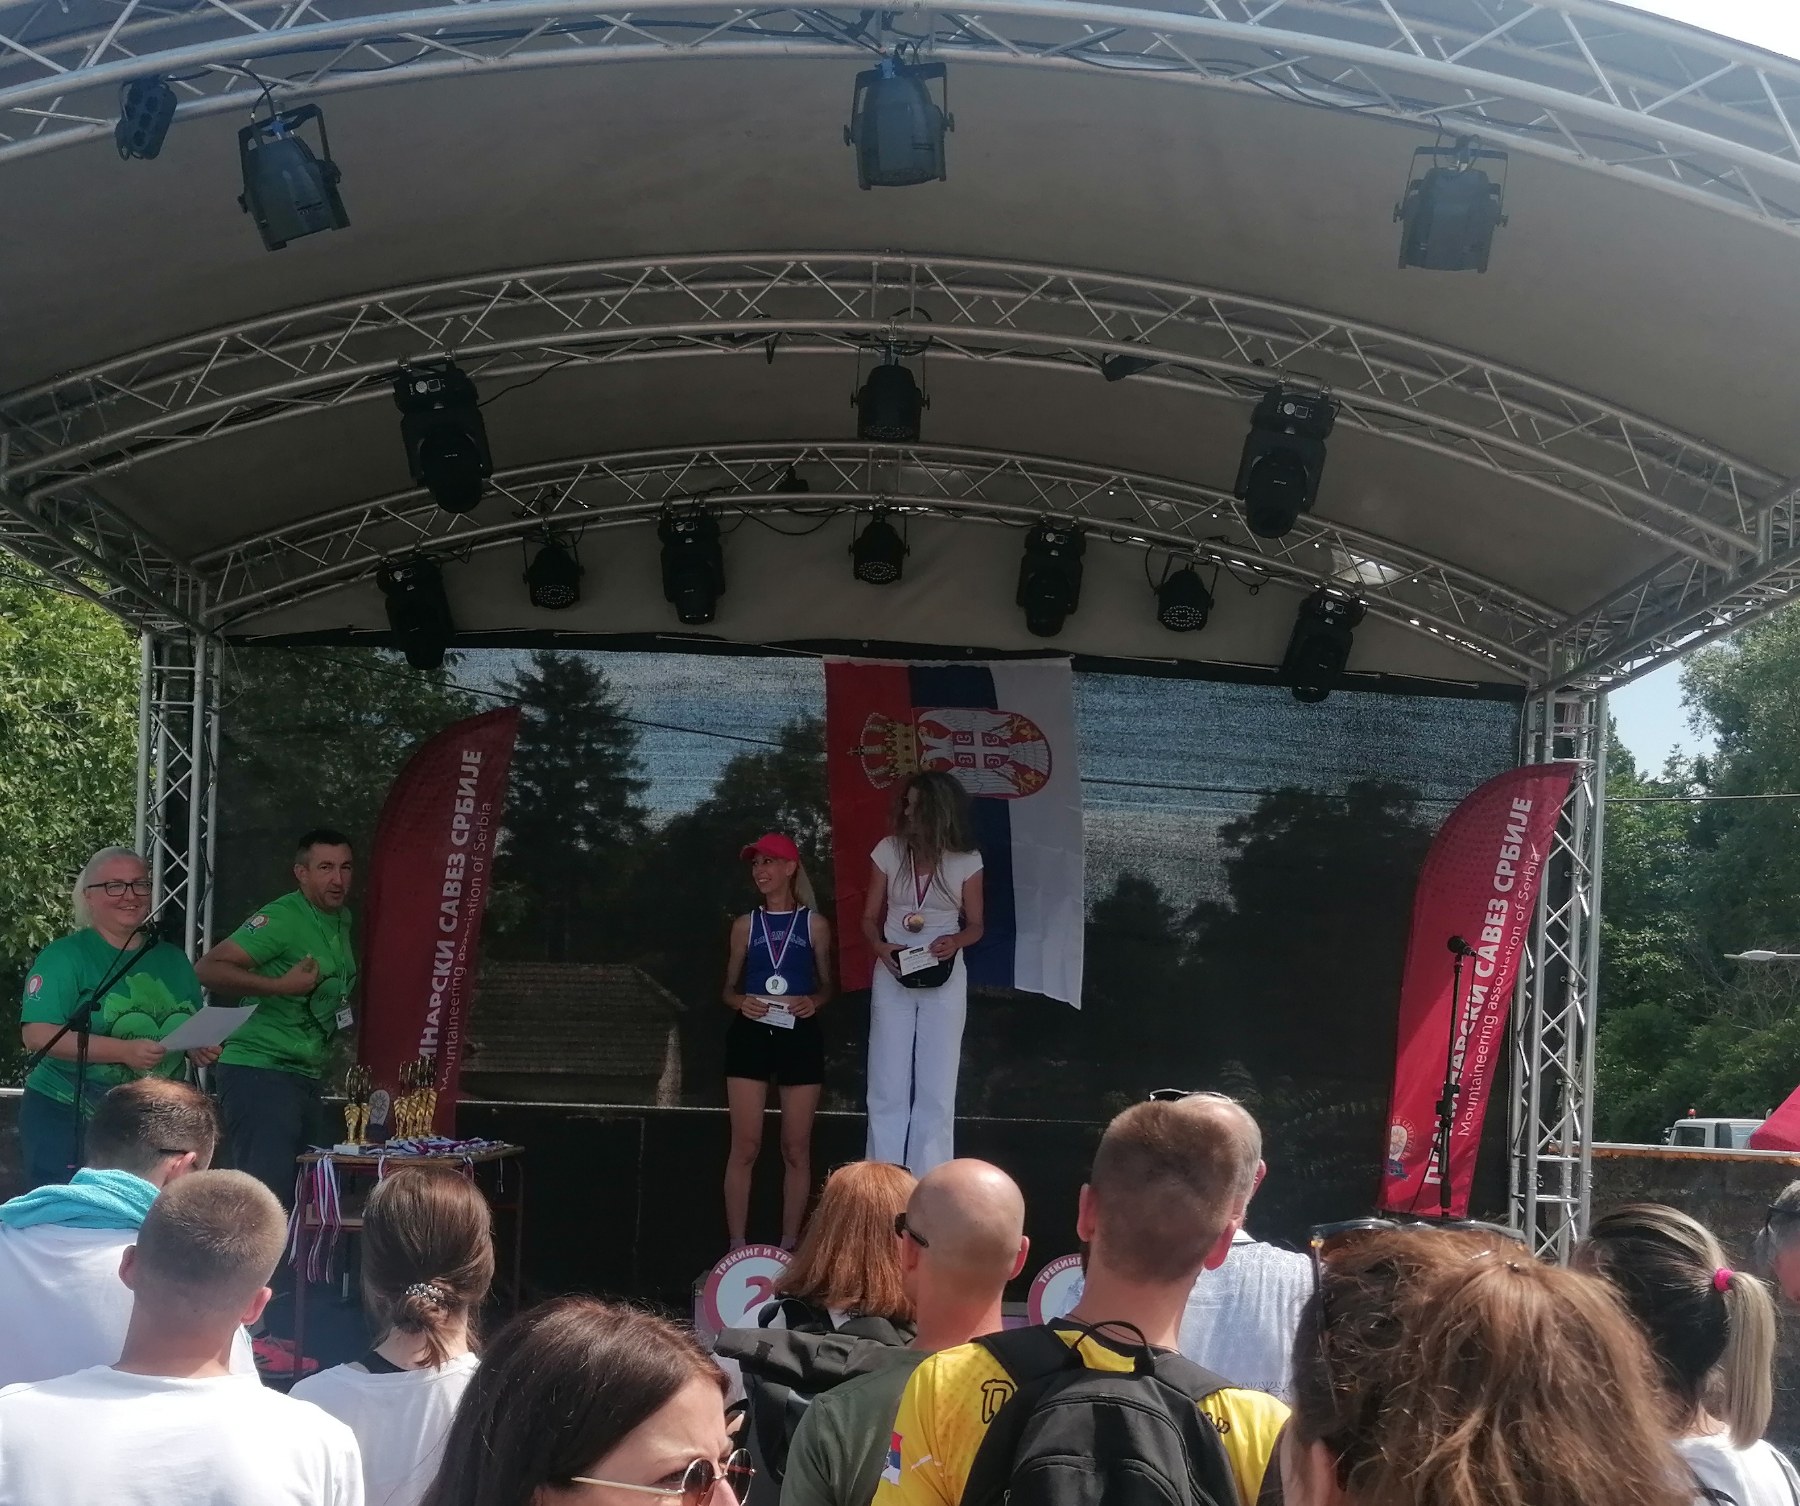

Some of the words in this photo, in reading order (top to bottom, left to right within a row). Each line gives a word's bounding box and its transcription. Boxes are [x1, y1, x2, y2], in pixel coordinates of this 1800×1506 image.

[451, 750, 482, 846] СРБИЈЕ
[473, 802, 492, 852] Serbia
[438, 852, 466, 933] САВЕЗ
[471, 855, 484, 873] of
[1475, 898, 1509, 978] САВЕЗ
[1493, 797, 1533, 893] СРБИЈЕ
[418, 940, 456, 1060] ИНАРСКИ
[1458, 1015, 1498, 1137] Mountaineering
[1514, 903, 1526, 921] of
[715, 1247, 760, 1275] ТРЕКИНГ
[763, 1247, 772, 1257] И
